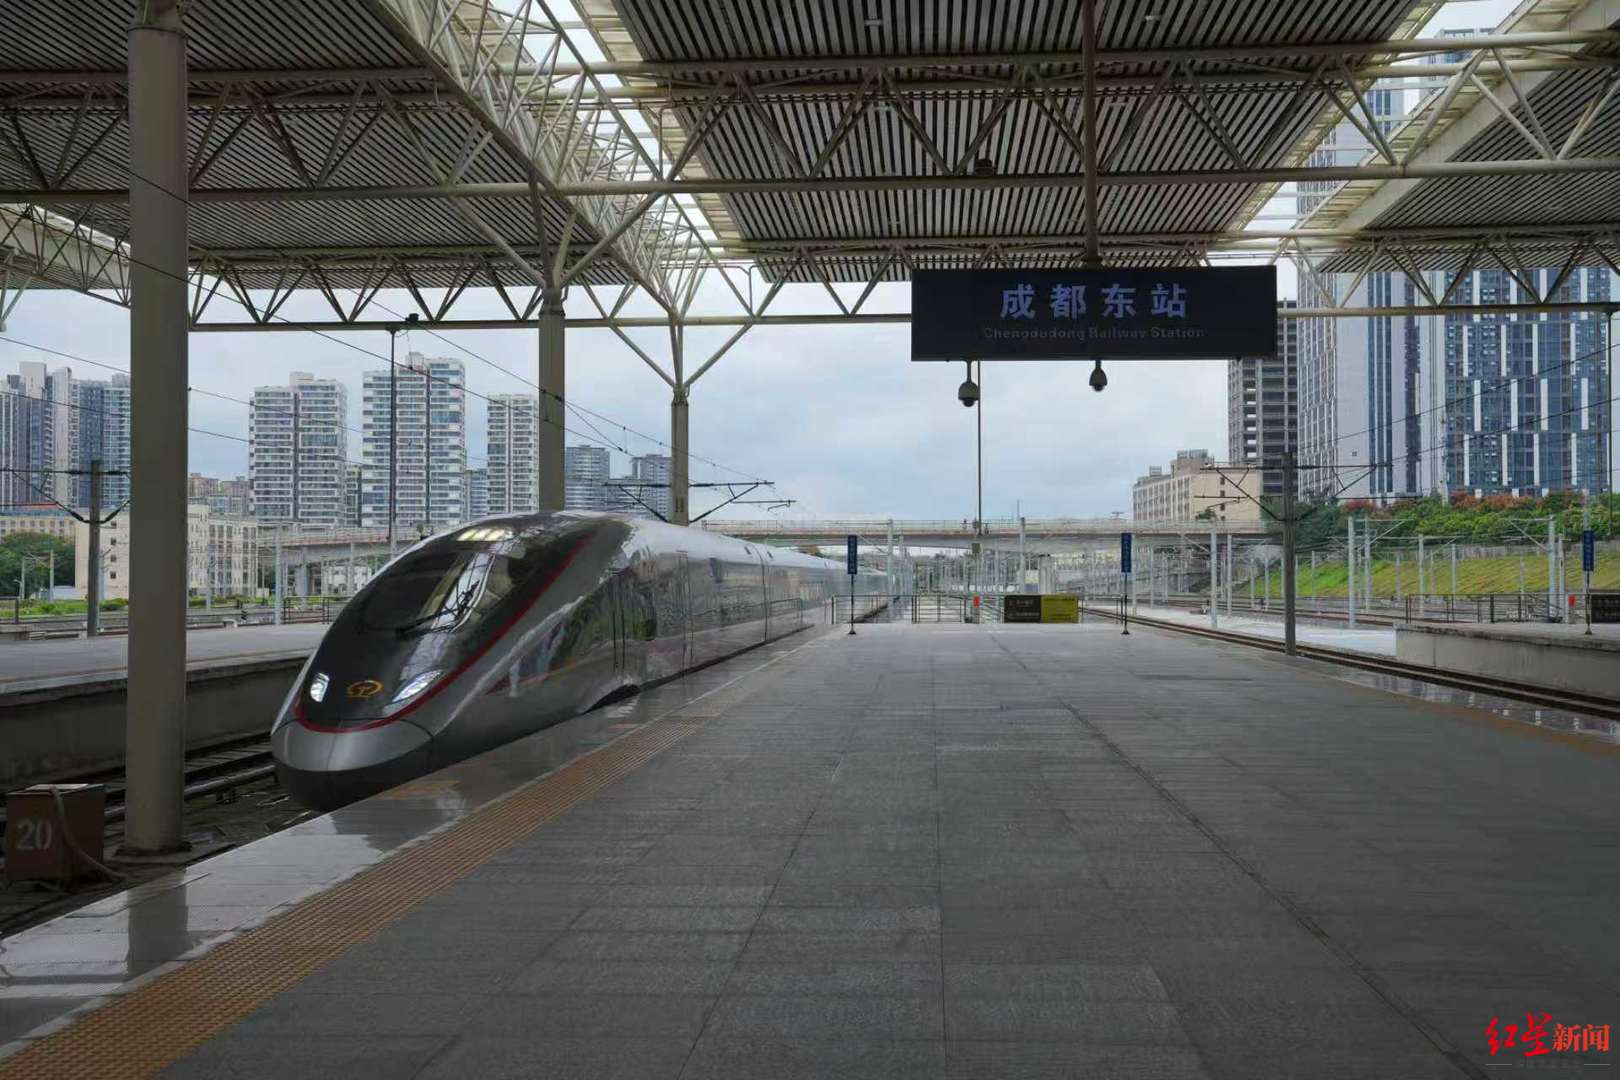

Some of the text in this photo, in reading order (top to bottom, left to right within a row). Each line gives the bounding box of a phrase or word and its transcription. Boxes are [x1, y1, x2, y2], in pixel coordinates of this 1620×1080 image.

[1000, 283, 1188, 319] 成都东站
[984, 326, 1204, 341] Chengdudong Railway Station
[17, 818, 52, 850] 20
